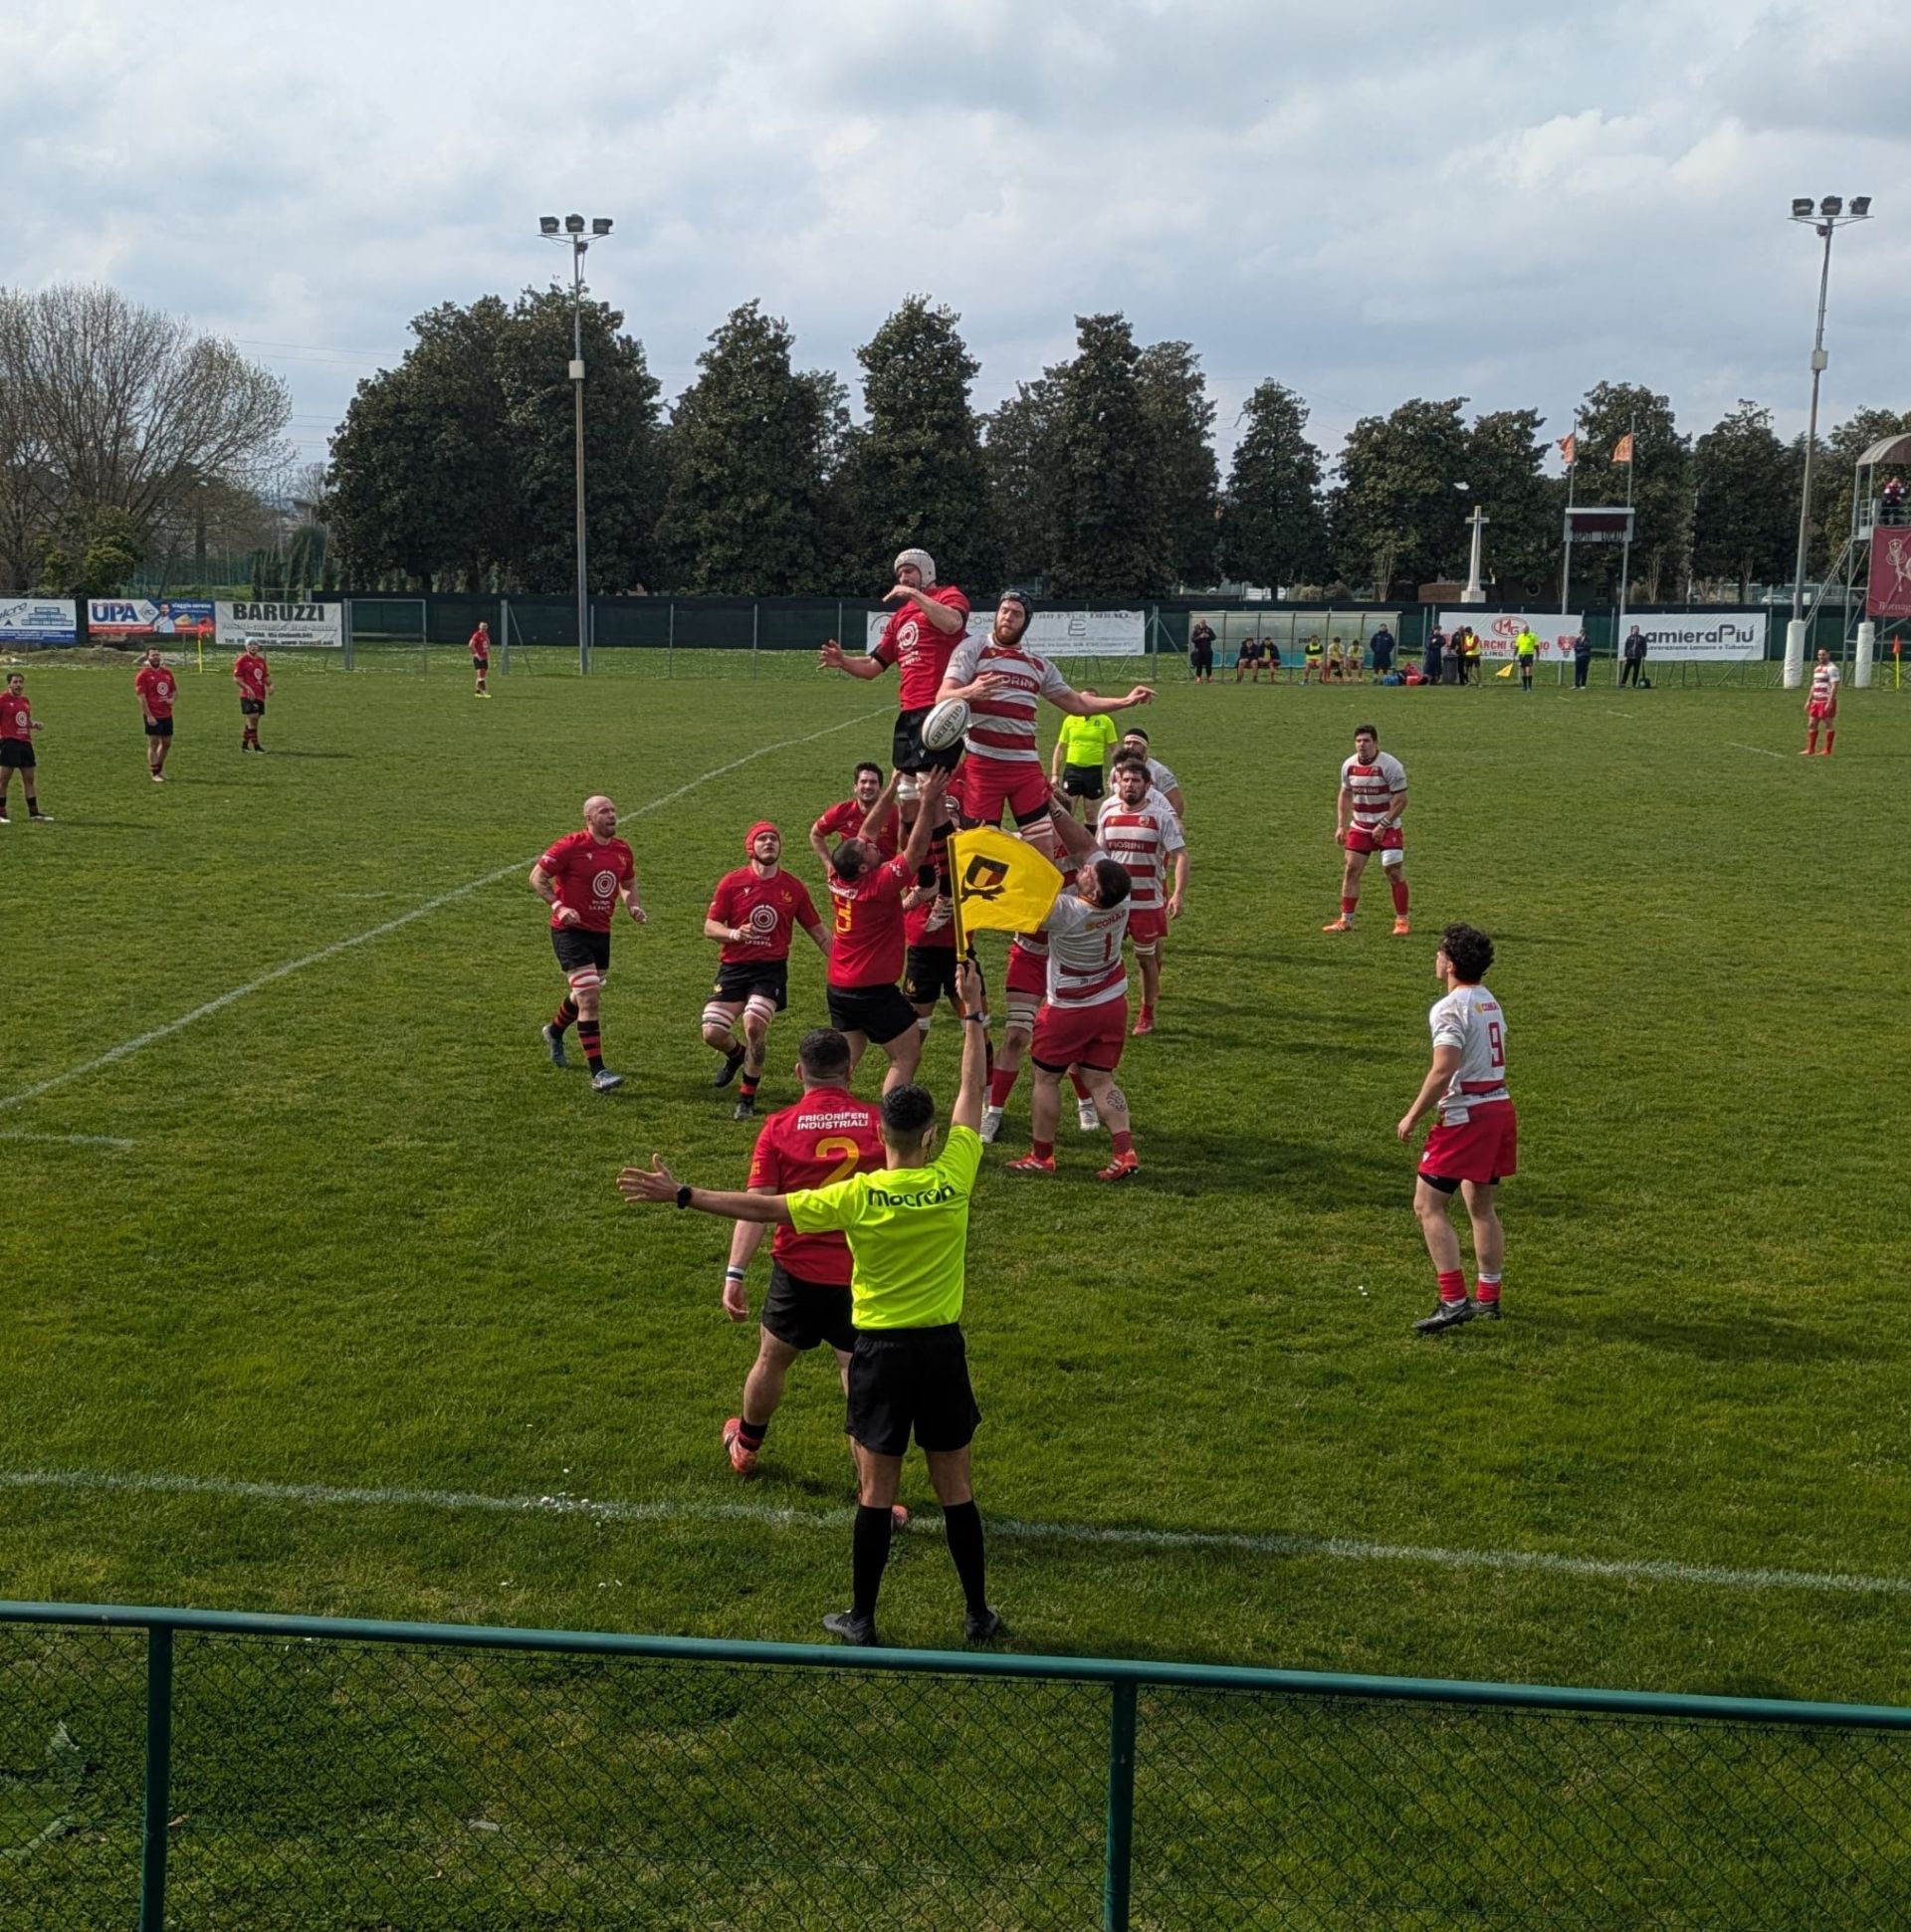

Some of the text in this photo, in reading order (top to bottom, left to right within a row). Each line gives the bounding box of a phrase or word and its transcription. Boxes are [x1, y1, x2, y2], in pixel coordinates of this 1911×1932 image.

[92, 603, 138, 622] UPA
[233, 603, 325, 621] BARUZZI
[1478, 639, 1507, 650] ARCHI
[932, 705, 963, 744] GILBERT
[1104, 932, 1113, 963] 1
[1489, 1021, 1504, 1067] 9
[797, 1112, 869, 1122] FRIGORIFERI
[797, 1121, 869, 1131] INDUSTRIALI
[816, 1137, 860, 1188] 2
